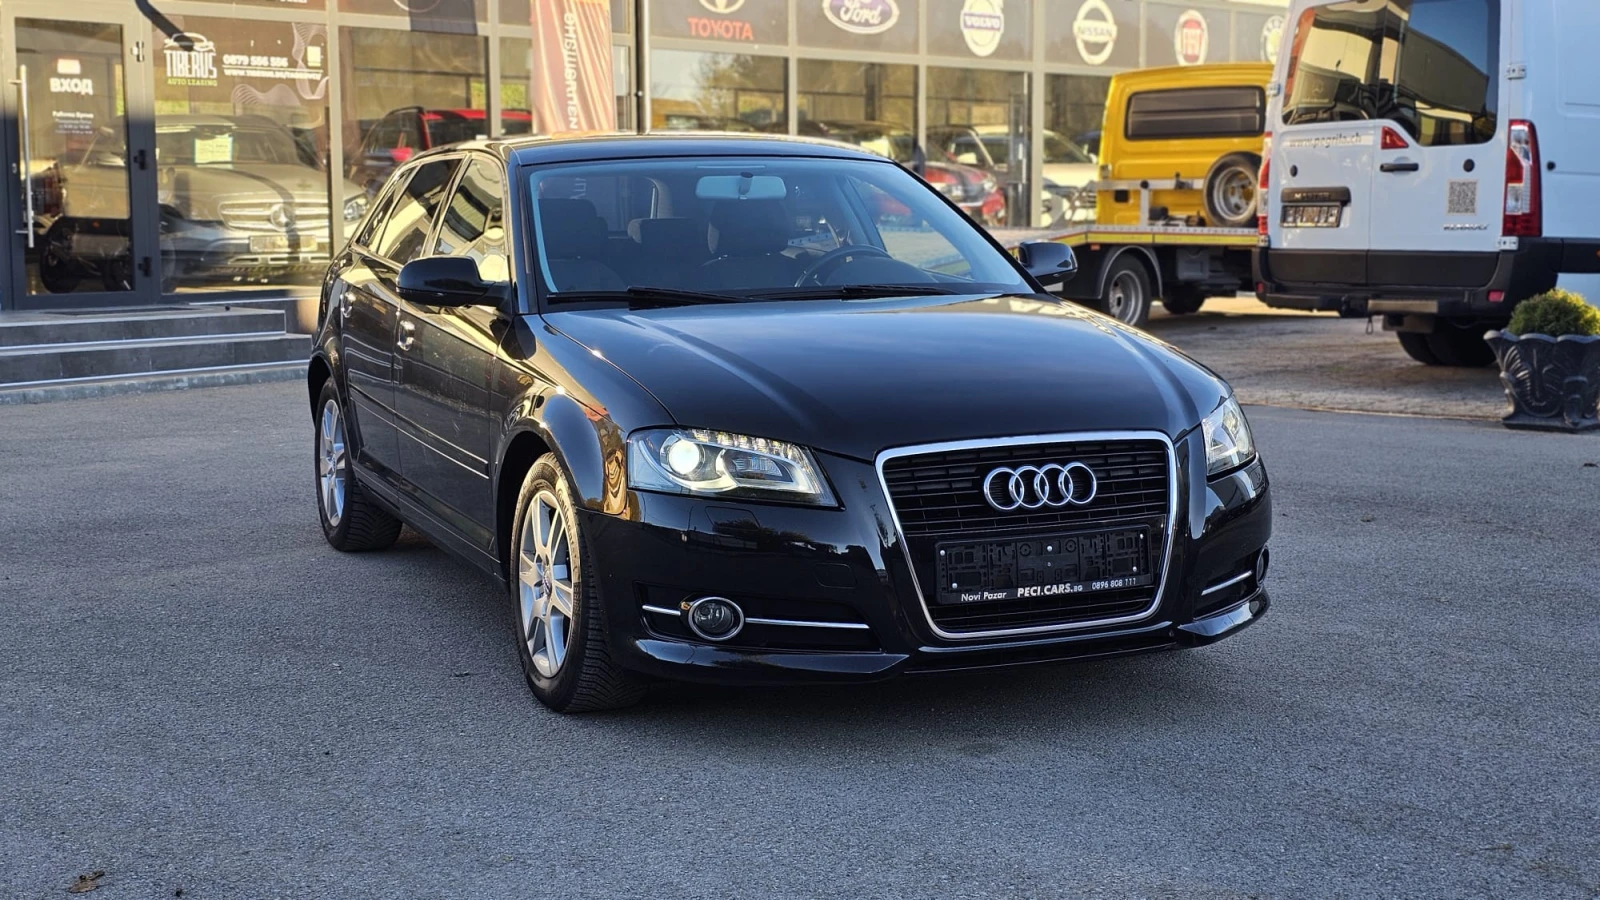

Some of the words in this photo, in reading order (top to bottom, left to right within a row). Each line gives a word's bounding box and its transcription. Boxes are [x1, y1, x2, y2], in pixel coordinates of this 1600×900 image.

[840, 0, 882, 24] Ford
[965, 15, 1001, 28] VOLVO
[687, 17, 754, 41] TOYOTA
[1077, 25, 1113, 37] NISSAN
[163, 50, 218, 79] TIBERUS
[49, 77, 94, 96] ВХОД
[961, 592, 982, 602] Novi
[983, 591, 1007, 600] Pazar
[1017, 583, 1083, 598] PECI.CARS.BG
[1091, 581, 1109, 590] 0896
[1110, 579, 1123, 588] 808
